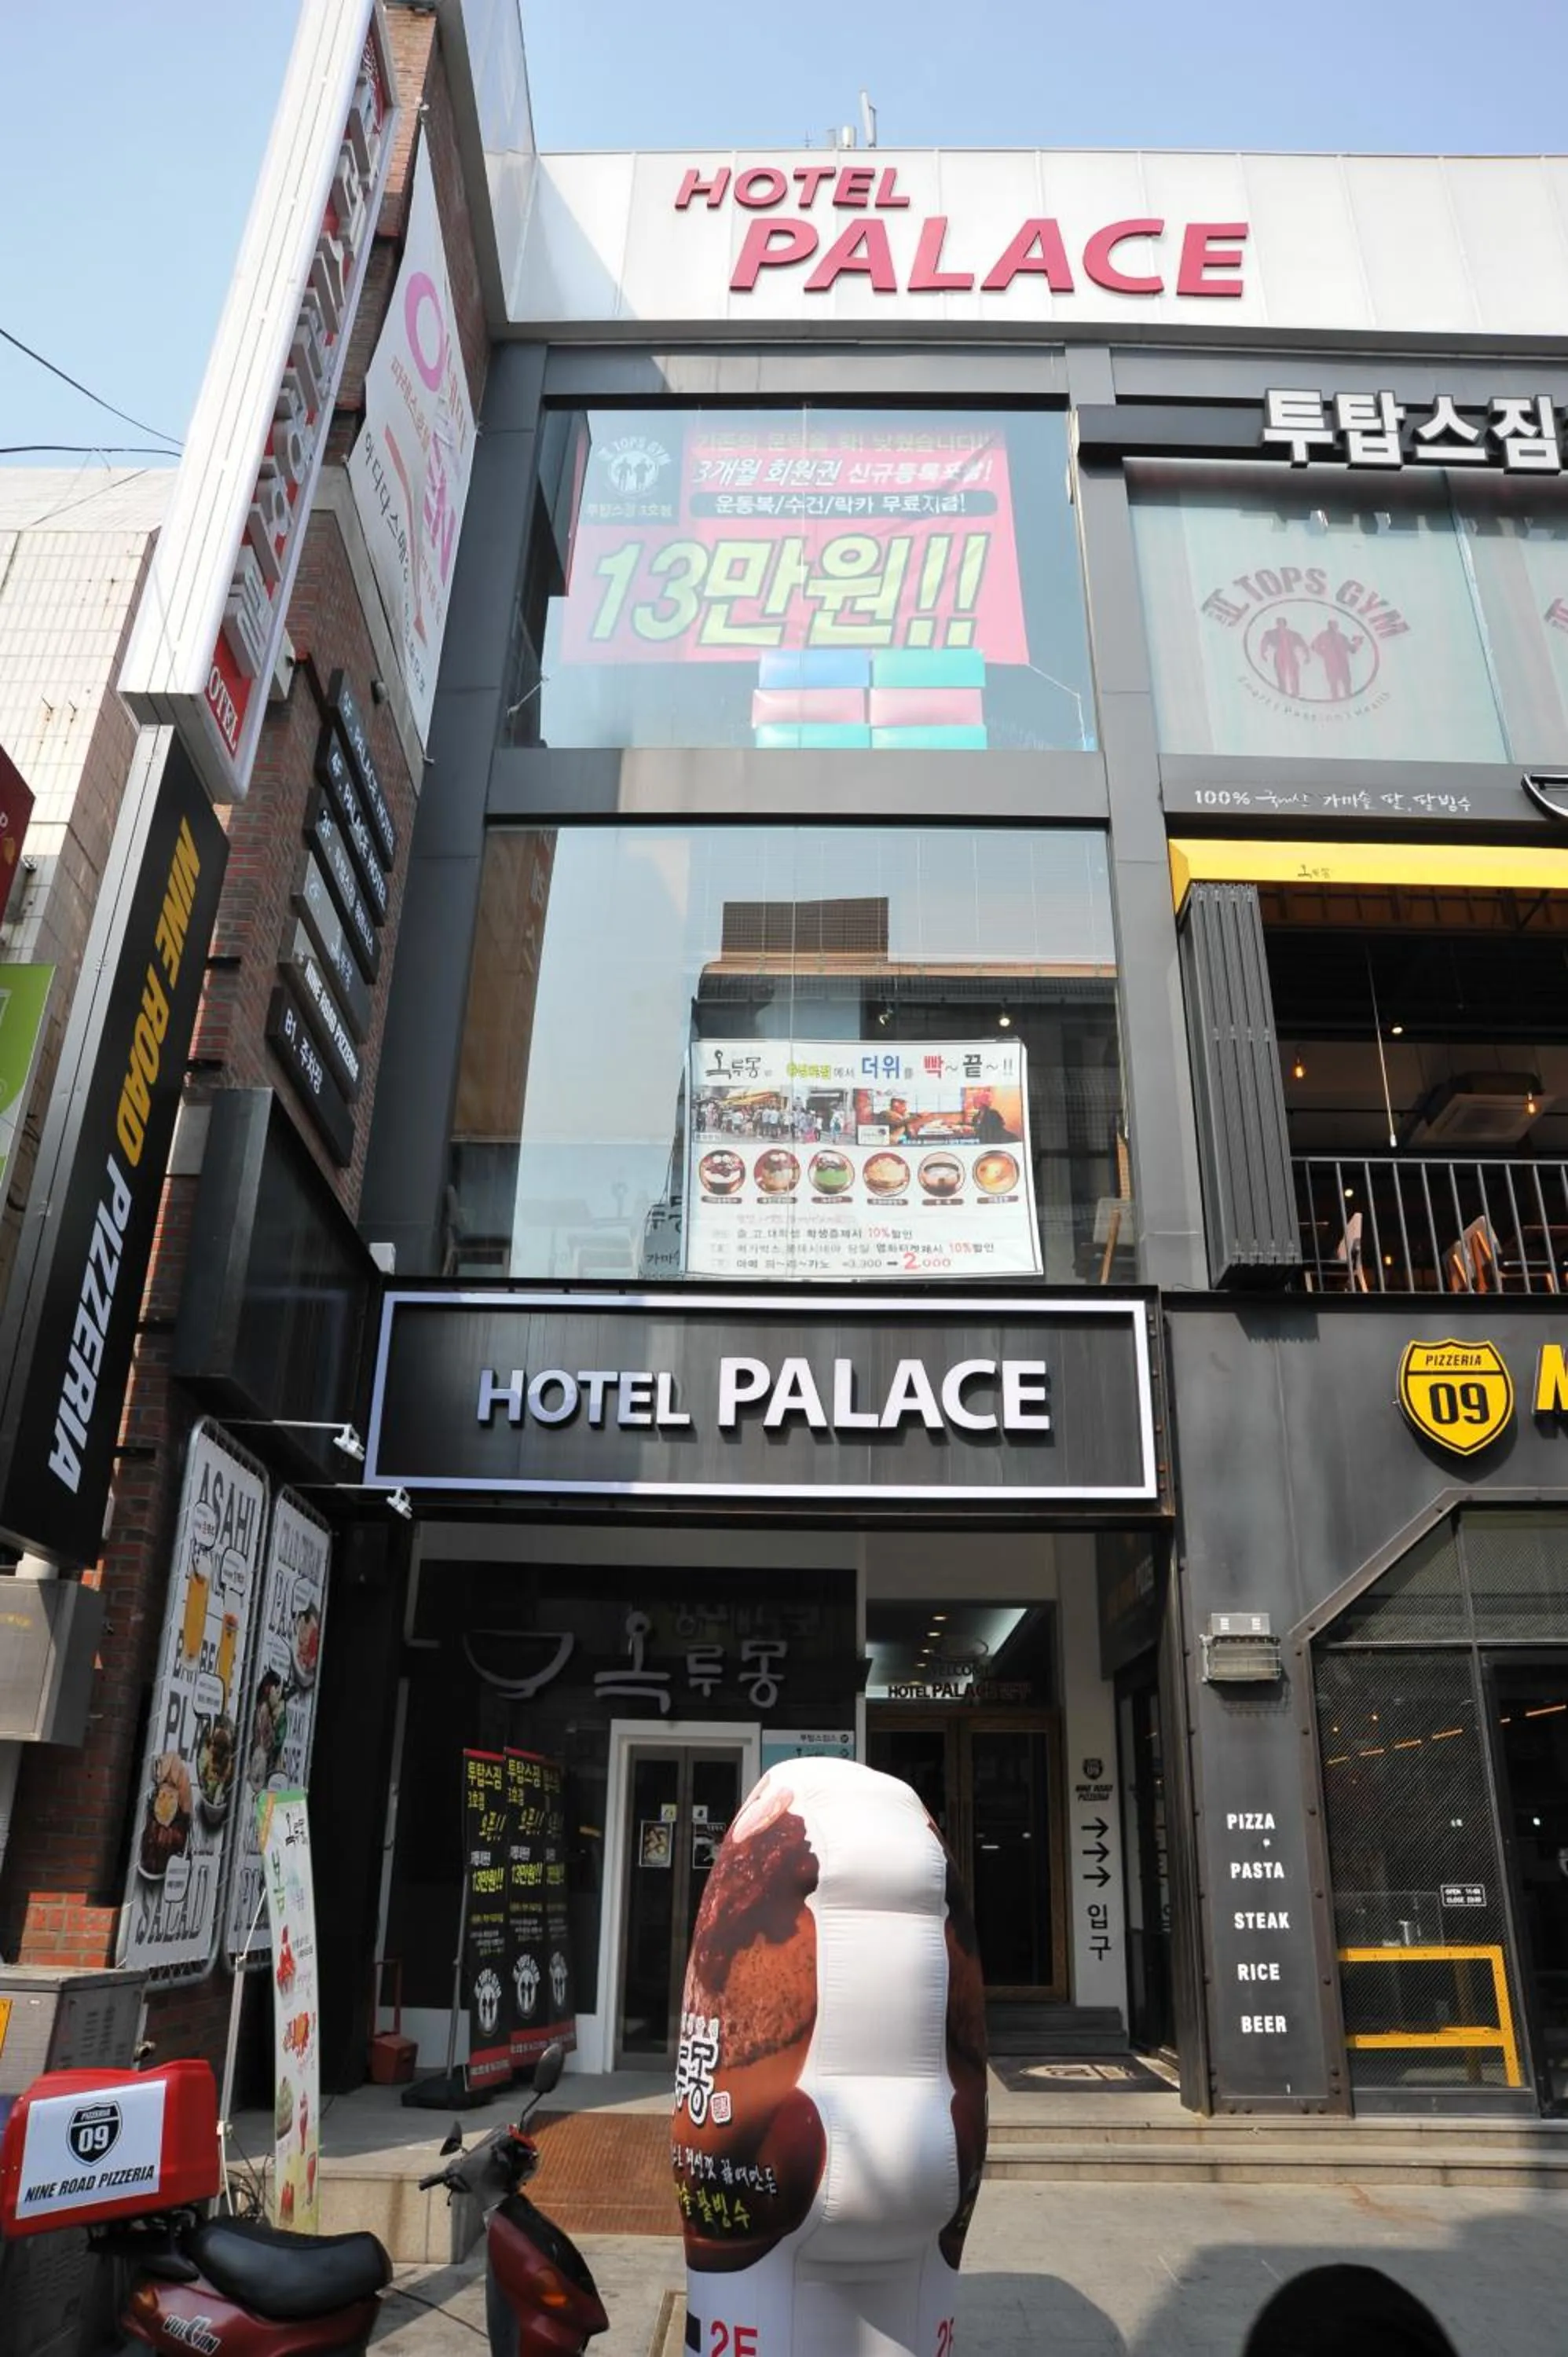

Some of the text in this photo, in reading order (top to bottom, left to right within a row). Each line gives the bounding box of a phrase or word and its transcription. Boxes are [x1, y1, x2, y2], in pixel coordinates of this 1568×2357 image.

[675, 167, 910, 210] HOTEL
[730, 217, 1248, 297] PALACE
[1262, 388, 1562, 475] 투탑스짐
[692, 458, 763, 486] 3개월
[763, 458, 843, 486] 회원권
[882, 492, 966, 514] 무료지급!
[586, 532, 991, 650] 13만원!!
[1233, 566, 1327, 602] TOPS
[1336, 579, 1411, 639] GYM
[1194, 789, 1251, 807] 100%
[48, 815, 201, 1495] NINE ROAD PIZZERIA
[1424, 1354, 1483, 1367] PIZZERIA
[476, 1357, 1051, 1432] HOTEL PALACE
[1428, 1382, 1489, 1425] 09
[199, 1461, 258, 1558] ASAHI
[595, 1610, 788, 1715] 옥루몽
[888, 1684, 931, 1699] HOTEL
[932, 1681, 994, 1699] PALAC
[467, 1760, 503, 1791] 투탑스짐
[507, 1758, 541, 1788] 투탑스짐
[1226, 1813, 1276, 1831] PIZZA
[1230, 1862, 1284, 1879] PASTA
[1087, 1903, 1112, 1962] 입구
[1234, 1912, 1291, 1930] STEAK
[1237, 1963, 1280, 1981] RICE
[1240, 2015, 1288, 2034] BEER
[80, 2108, 112, 2121] PIZZERIA
[78, 2124, 110, 2152] 09
[24, 2164, 155, 2204] NINE ROAD PIZZERIA
[163, 2315, 221, 2356] VULCAN
